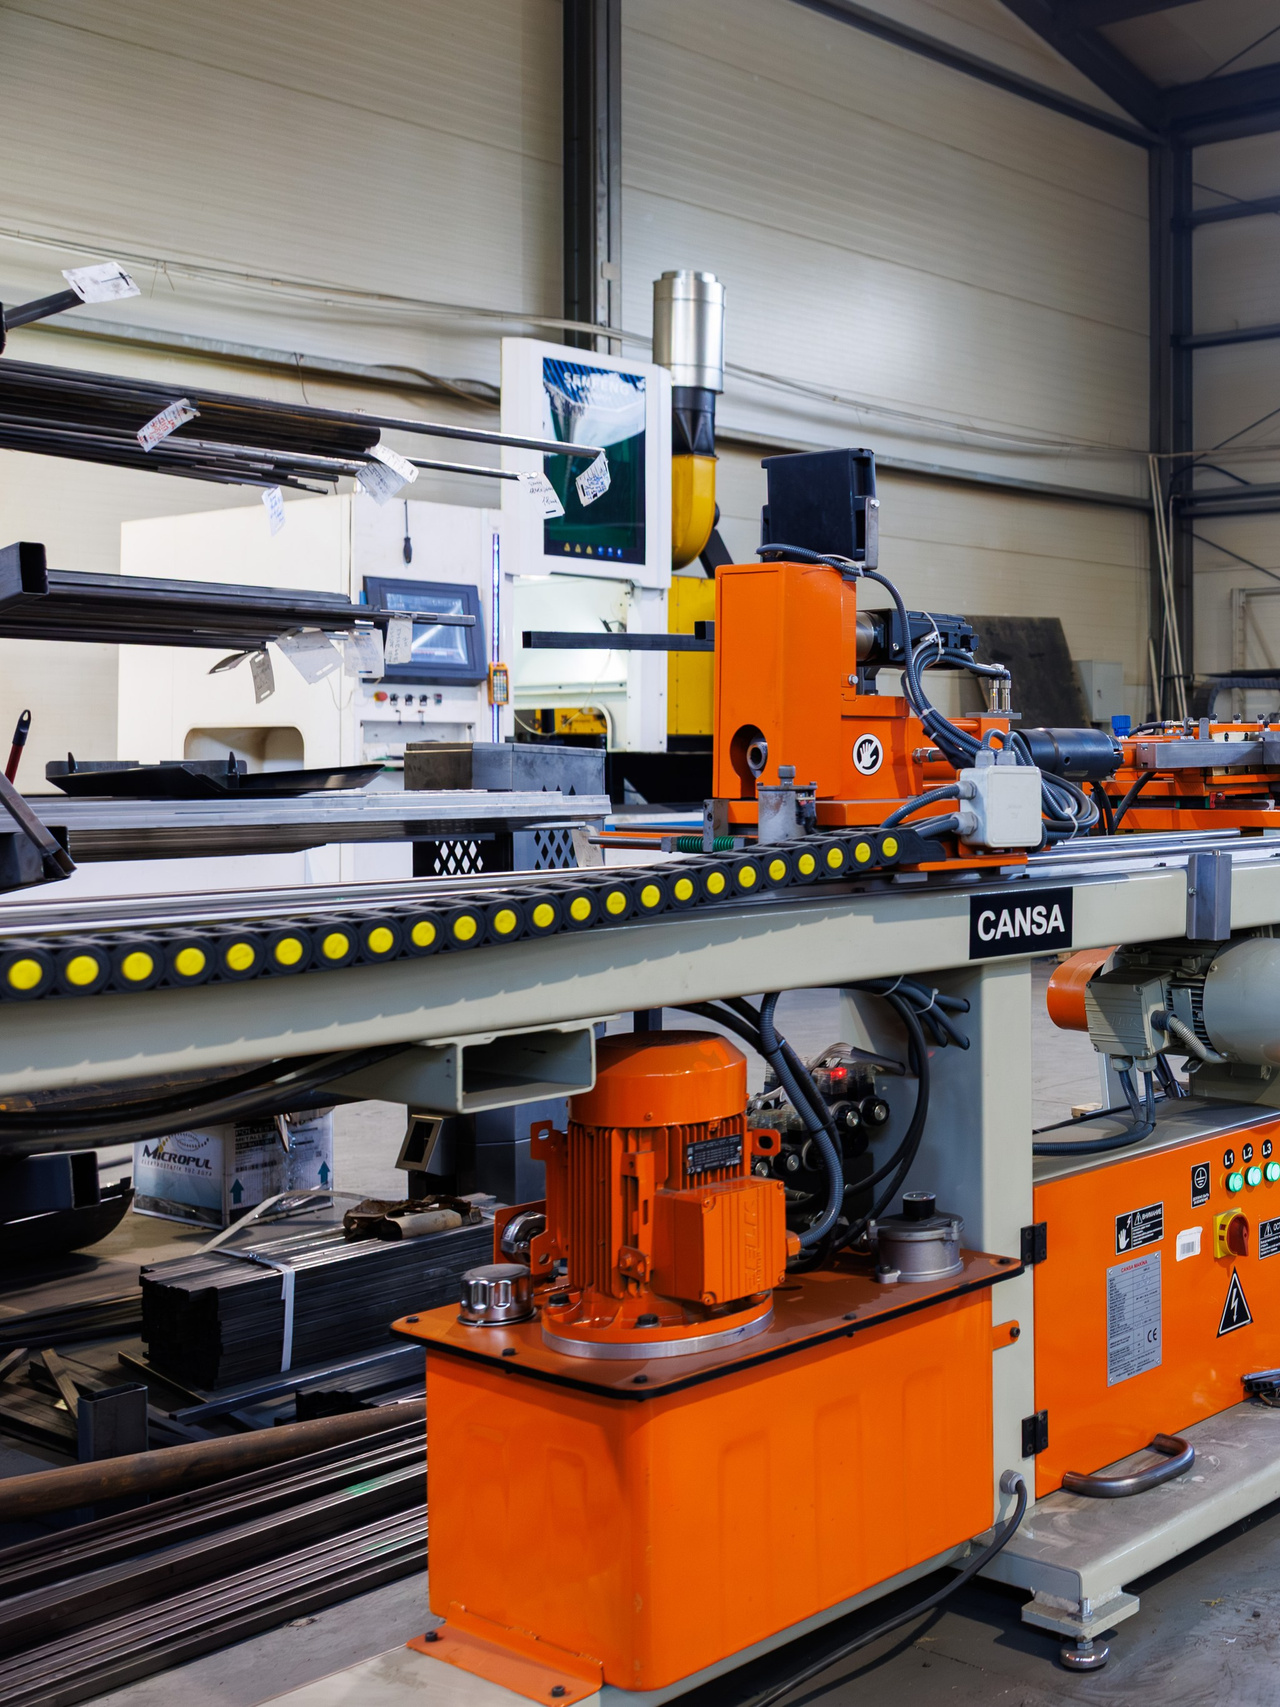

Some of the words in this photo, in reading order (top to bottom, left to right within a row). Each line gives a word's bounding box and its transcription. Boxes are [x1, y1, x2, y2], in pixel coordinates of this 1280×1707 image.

[976, 904, 1066, 942] CANSA
[1243, 1146, 1253, 1161] L2
[1262, 1143, 1272, 1156] L3
[1224, 1152, 1234, 1167] L1
